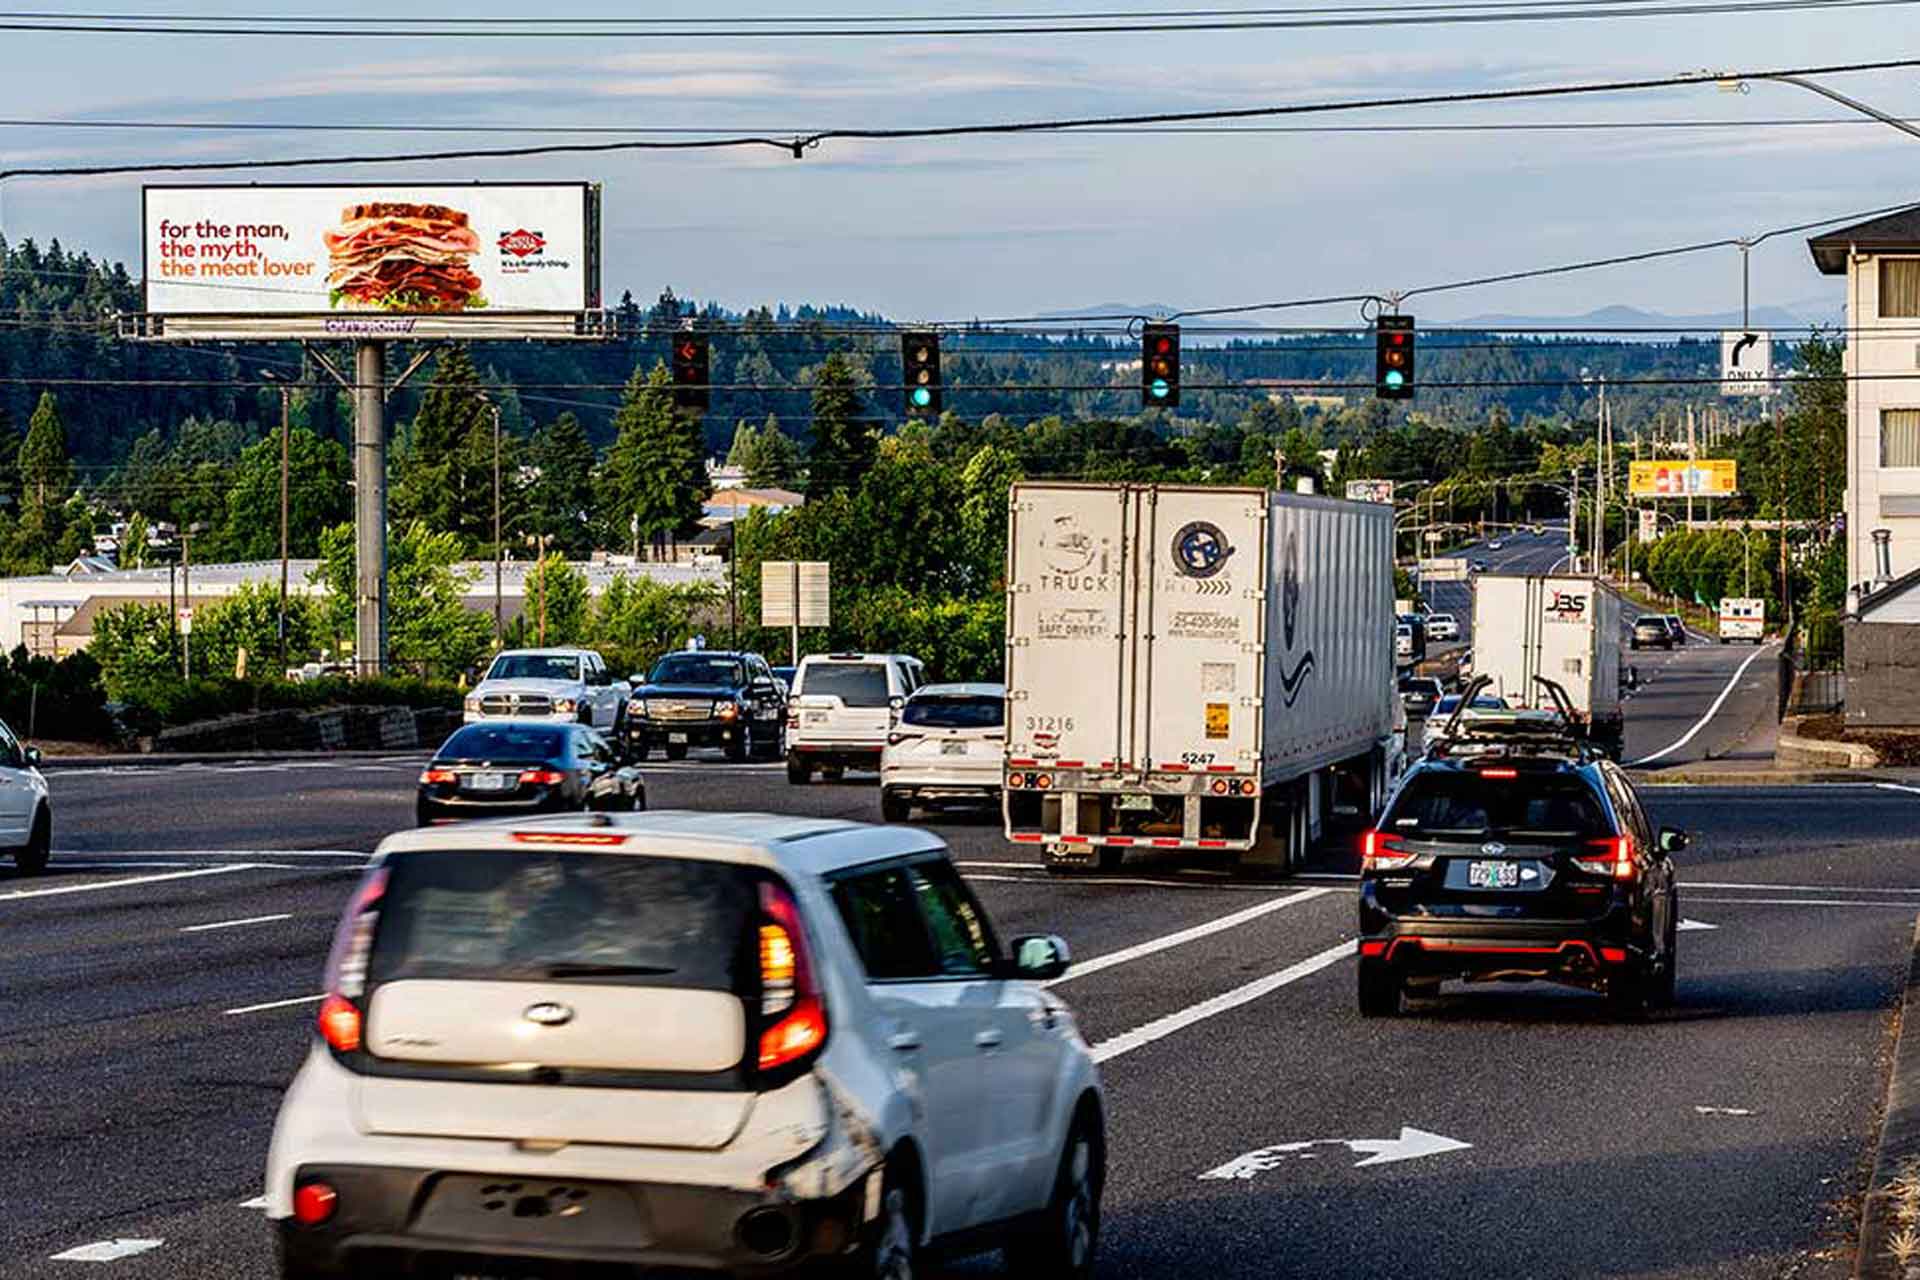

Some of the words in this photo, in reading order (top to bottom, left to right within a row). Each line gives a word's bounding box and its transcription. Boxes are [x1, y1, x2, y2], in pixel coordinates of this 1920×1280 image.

[160, 219, 190, 238] for
[196, 219, 231, 238] the
[236, 224, 289, 241] man,
[160, 240, 196, 258] the
[201, 240, 263, 261] myth,
[160, 259, 196, 276] the
[200, 260, 258, 276] meat
[263, 257, 315, 276] lover
[1728, 370, 1764, 382] ONLY
[1026, 716, 1074, 731] 31216
[1181, 752, 1215, 764] 5247
